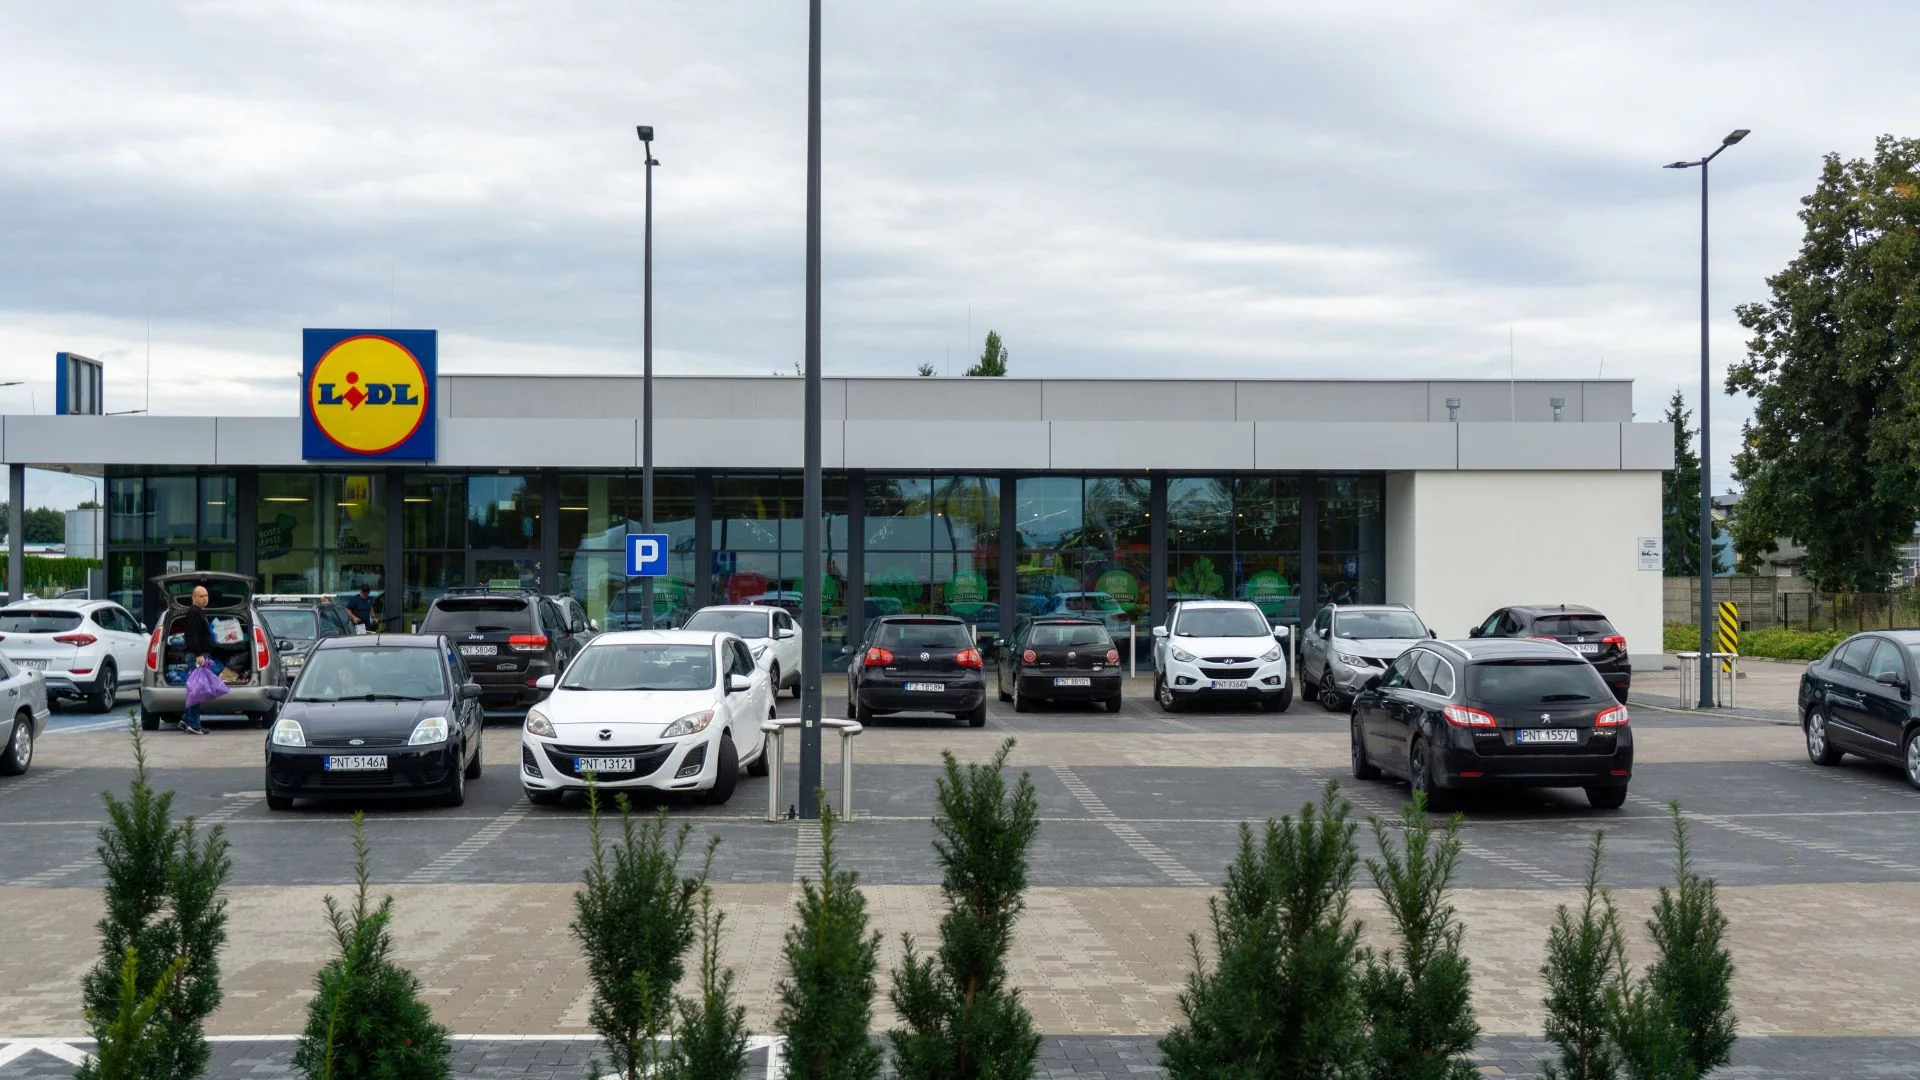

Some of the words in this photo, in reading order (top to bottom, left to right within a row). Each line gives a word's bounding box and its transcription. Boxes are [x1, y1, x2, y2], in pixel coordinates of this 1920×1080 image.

[635, 539, 659, 571] P
[1522, 730, 1542, 741] PNT
[1547, 730, 1576, 741] 1557C
[330, 757, 351, 768] PNT
[354, 757, 386, 768] 5146A
[580, 758, 599, 769] PNT
[602, 758, 634, 769] 13121
